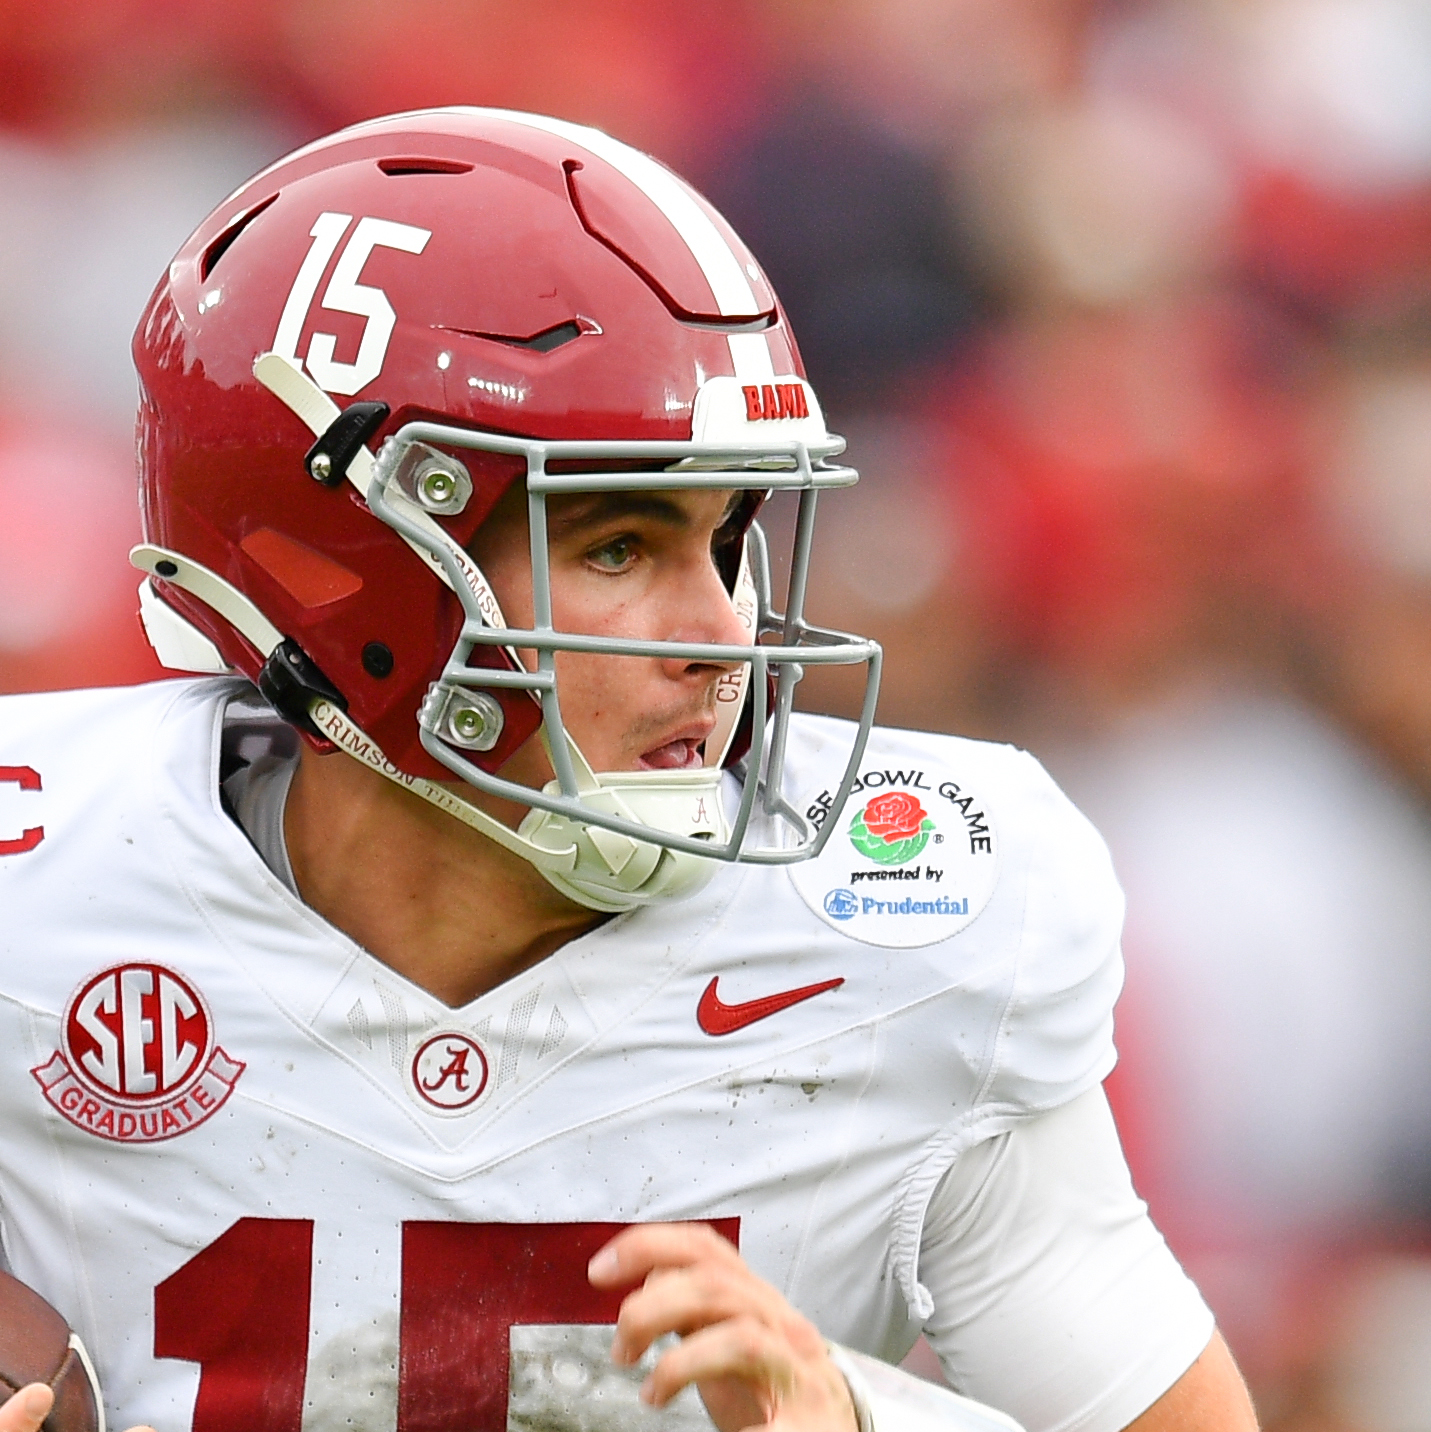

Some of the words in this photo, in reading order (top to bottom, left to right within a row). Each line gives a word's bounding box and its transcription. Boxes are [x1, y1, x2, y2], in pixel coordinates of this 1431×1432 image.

[271, 211, 433, 395] 15
[741, 384, 809, 421] BAMA
[315, 701, 416, 786] CRIMSON
[938, 782, 992, 854] GAME
[850, 866, 921, 885] presented
[925, 866, 943, 882] by
[861, 896, 969, 915] Prudential
[75, 969, 199, 1094] SEC
[60, 1085, 216, 1137] GRADUATE
